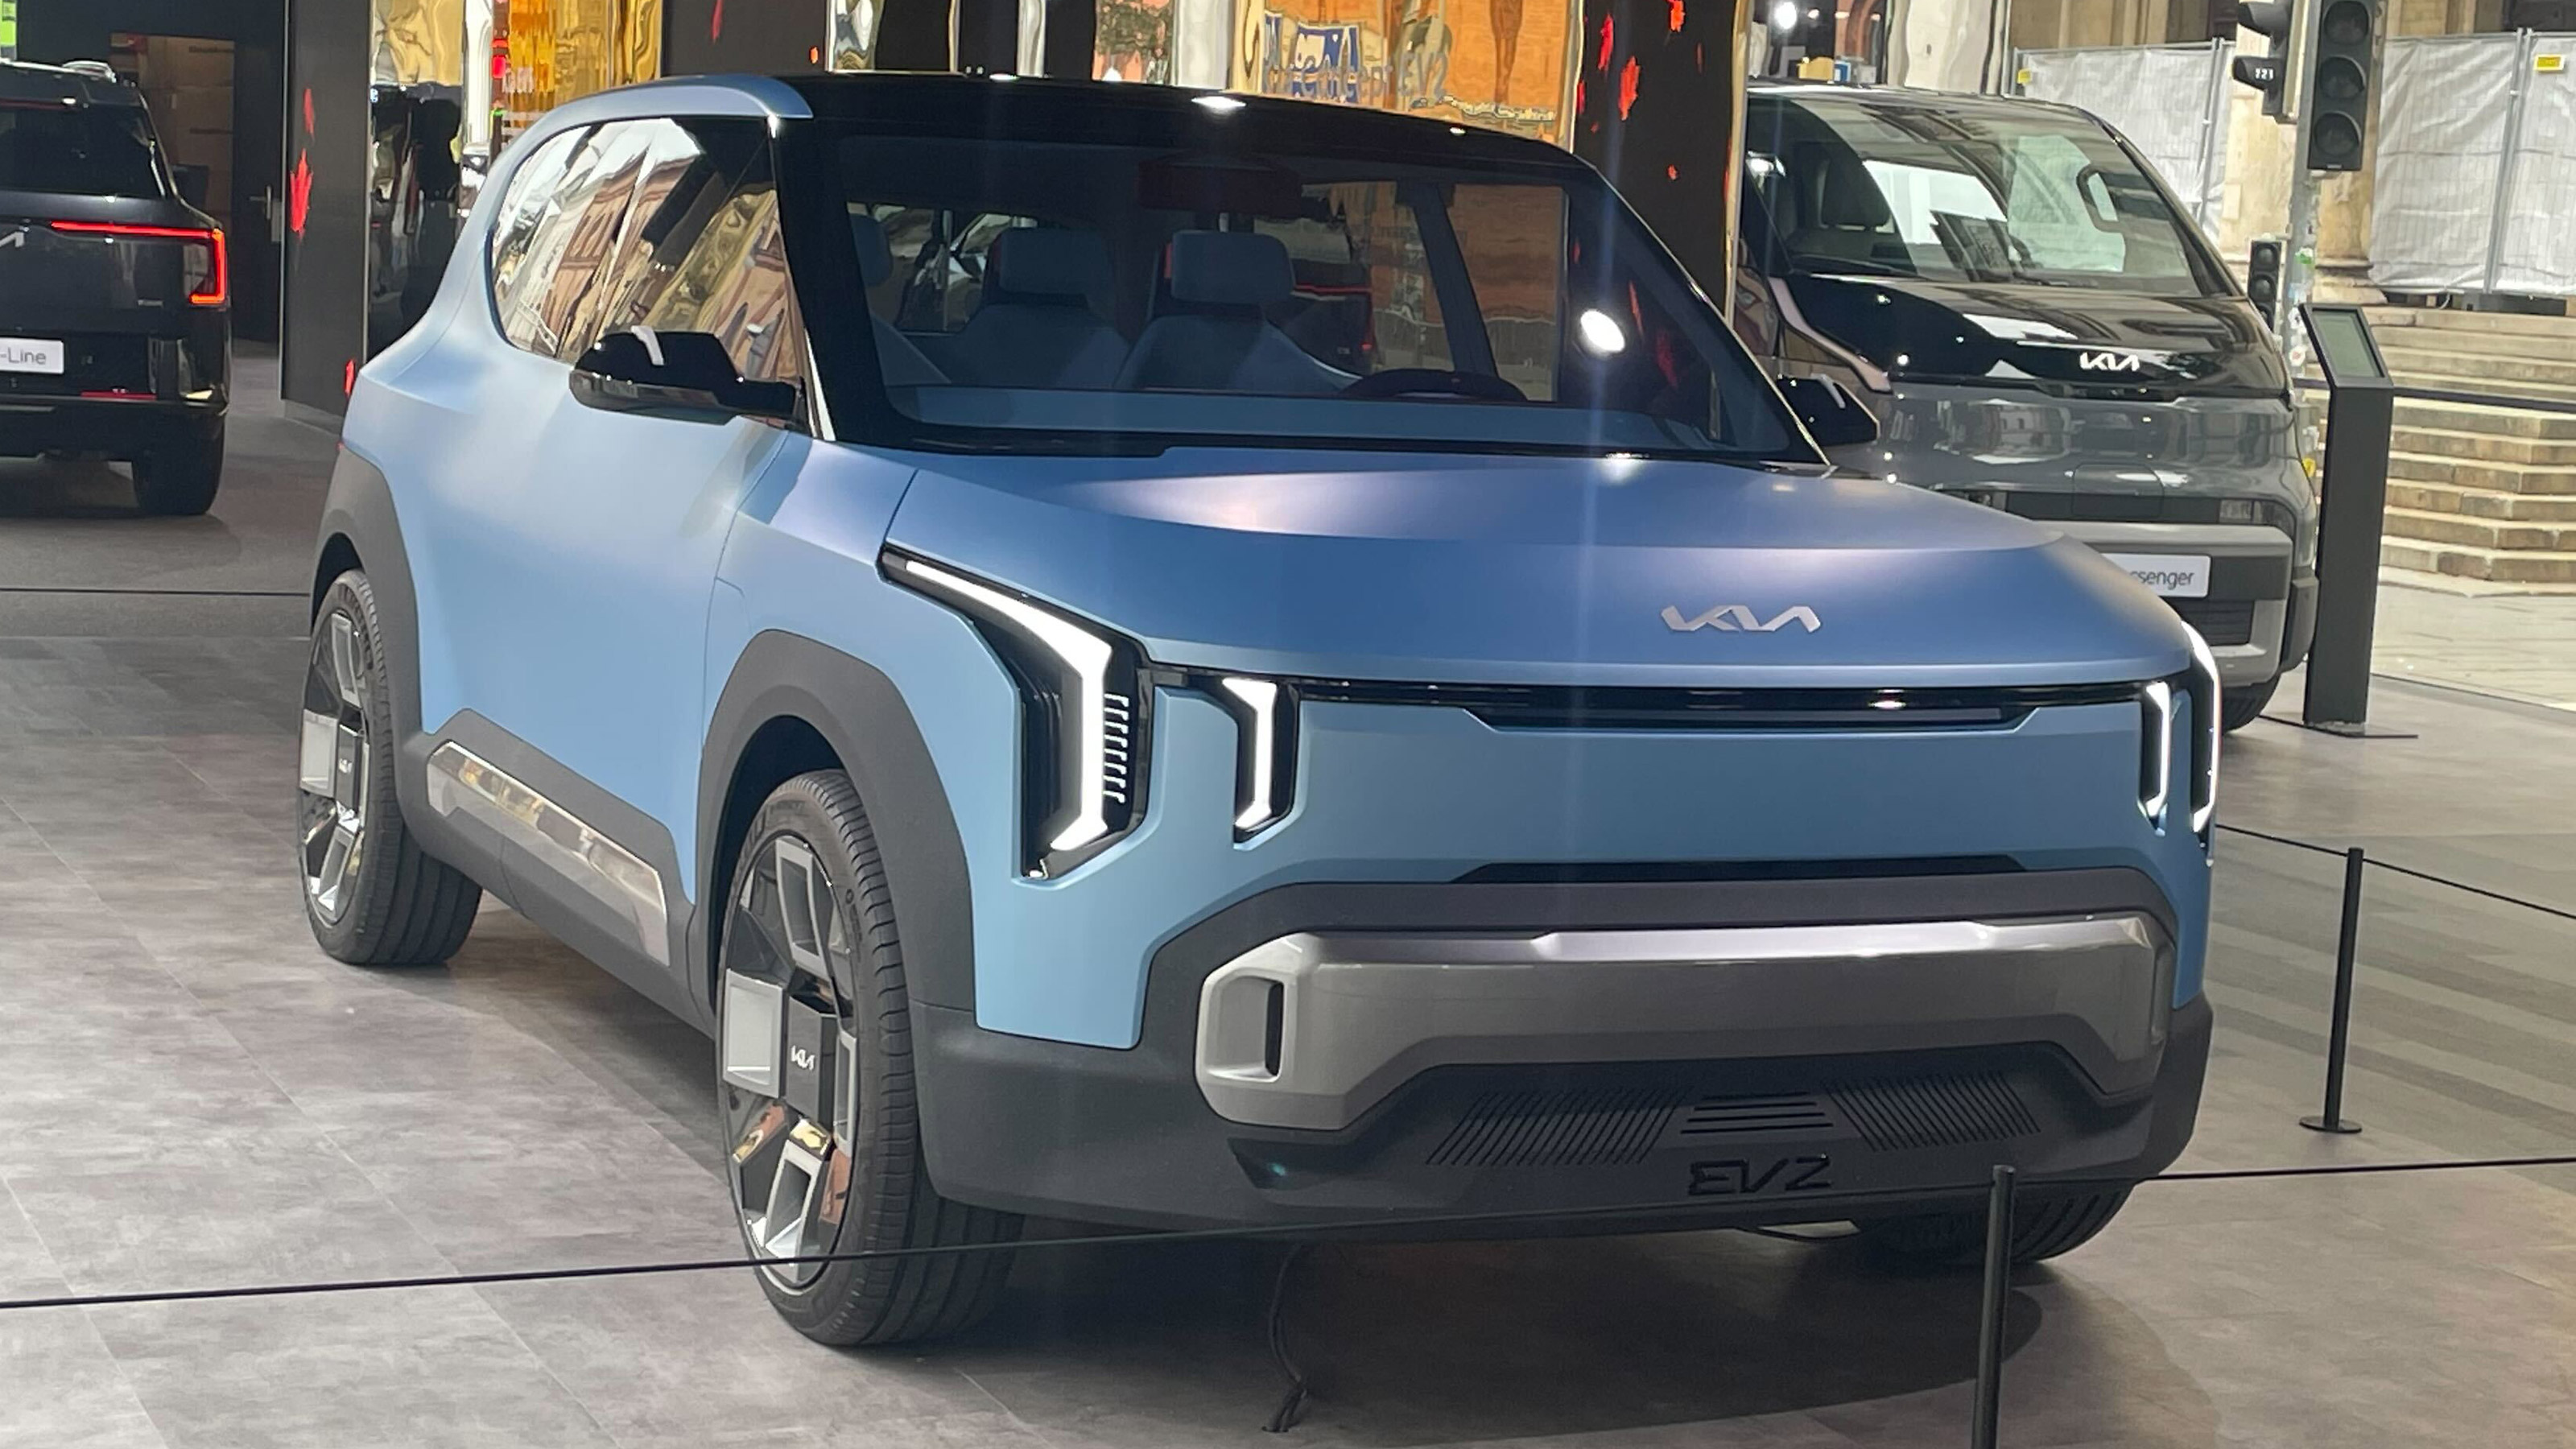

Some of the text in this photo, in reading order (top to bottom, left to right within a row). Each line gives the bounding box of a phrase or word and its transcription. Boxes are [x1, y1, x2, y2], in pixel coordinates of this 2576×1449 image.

[2079, 352, 2140, 371] KIA
[1661, 605, 1821, 633] KIA
[1688, 1155, 1833, 1195] EV2
